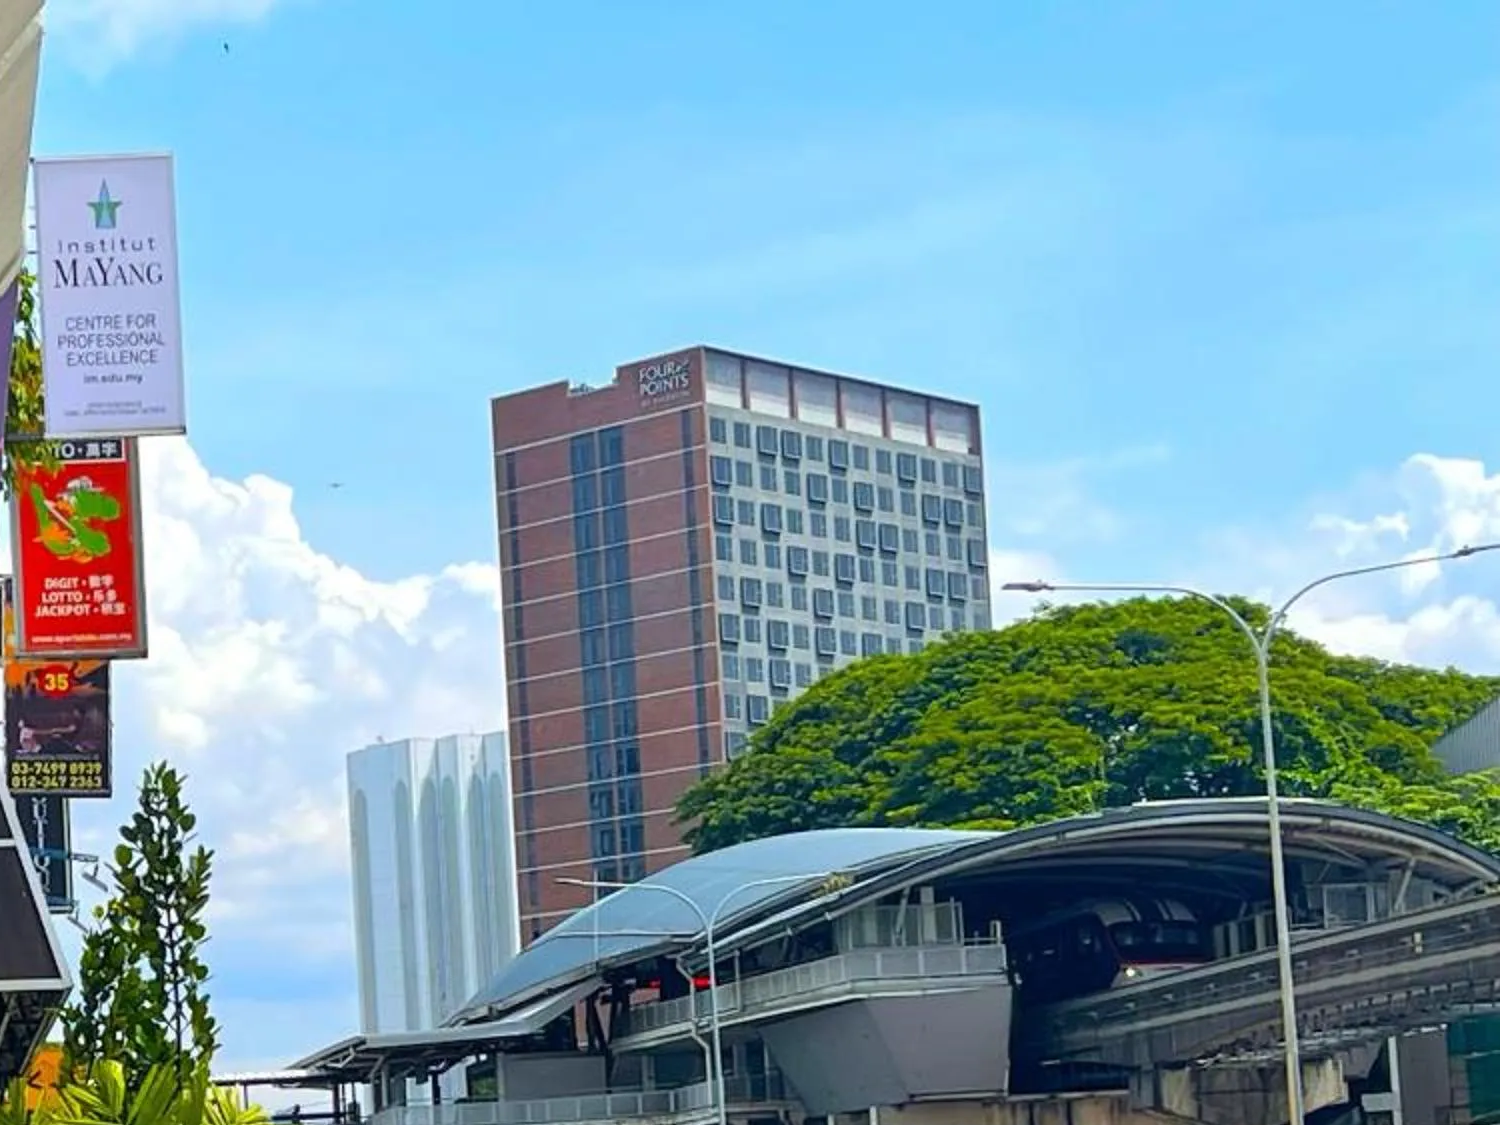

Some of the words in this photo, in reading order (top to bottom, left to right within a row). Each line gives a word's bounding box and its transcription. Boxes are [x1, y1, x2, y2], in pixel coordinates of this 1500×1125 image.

[65, 315, 123, 332] CENTRE
[127, 313, 157, 329] FOR
[58, 331, 165, 349] PROFESSIONAL
[66, 349, 158, 367] EXCELLENCE
[44, 577, 79, 590] DIGIT
[41, 592, 83, 604] LOTTO
[35, 603, 91, 618] JACKPOT
[44, 673, 69, 691] 35
